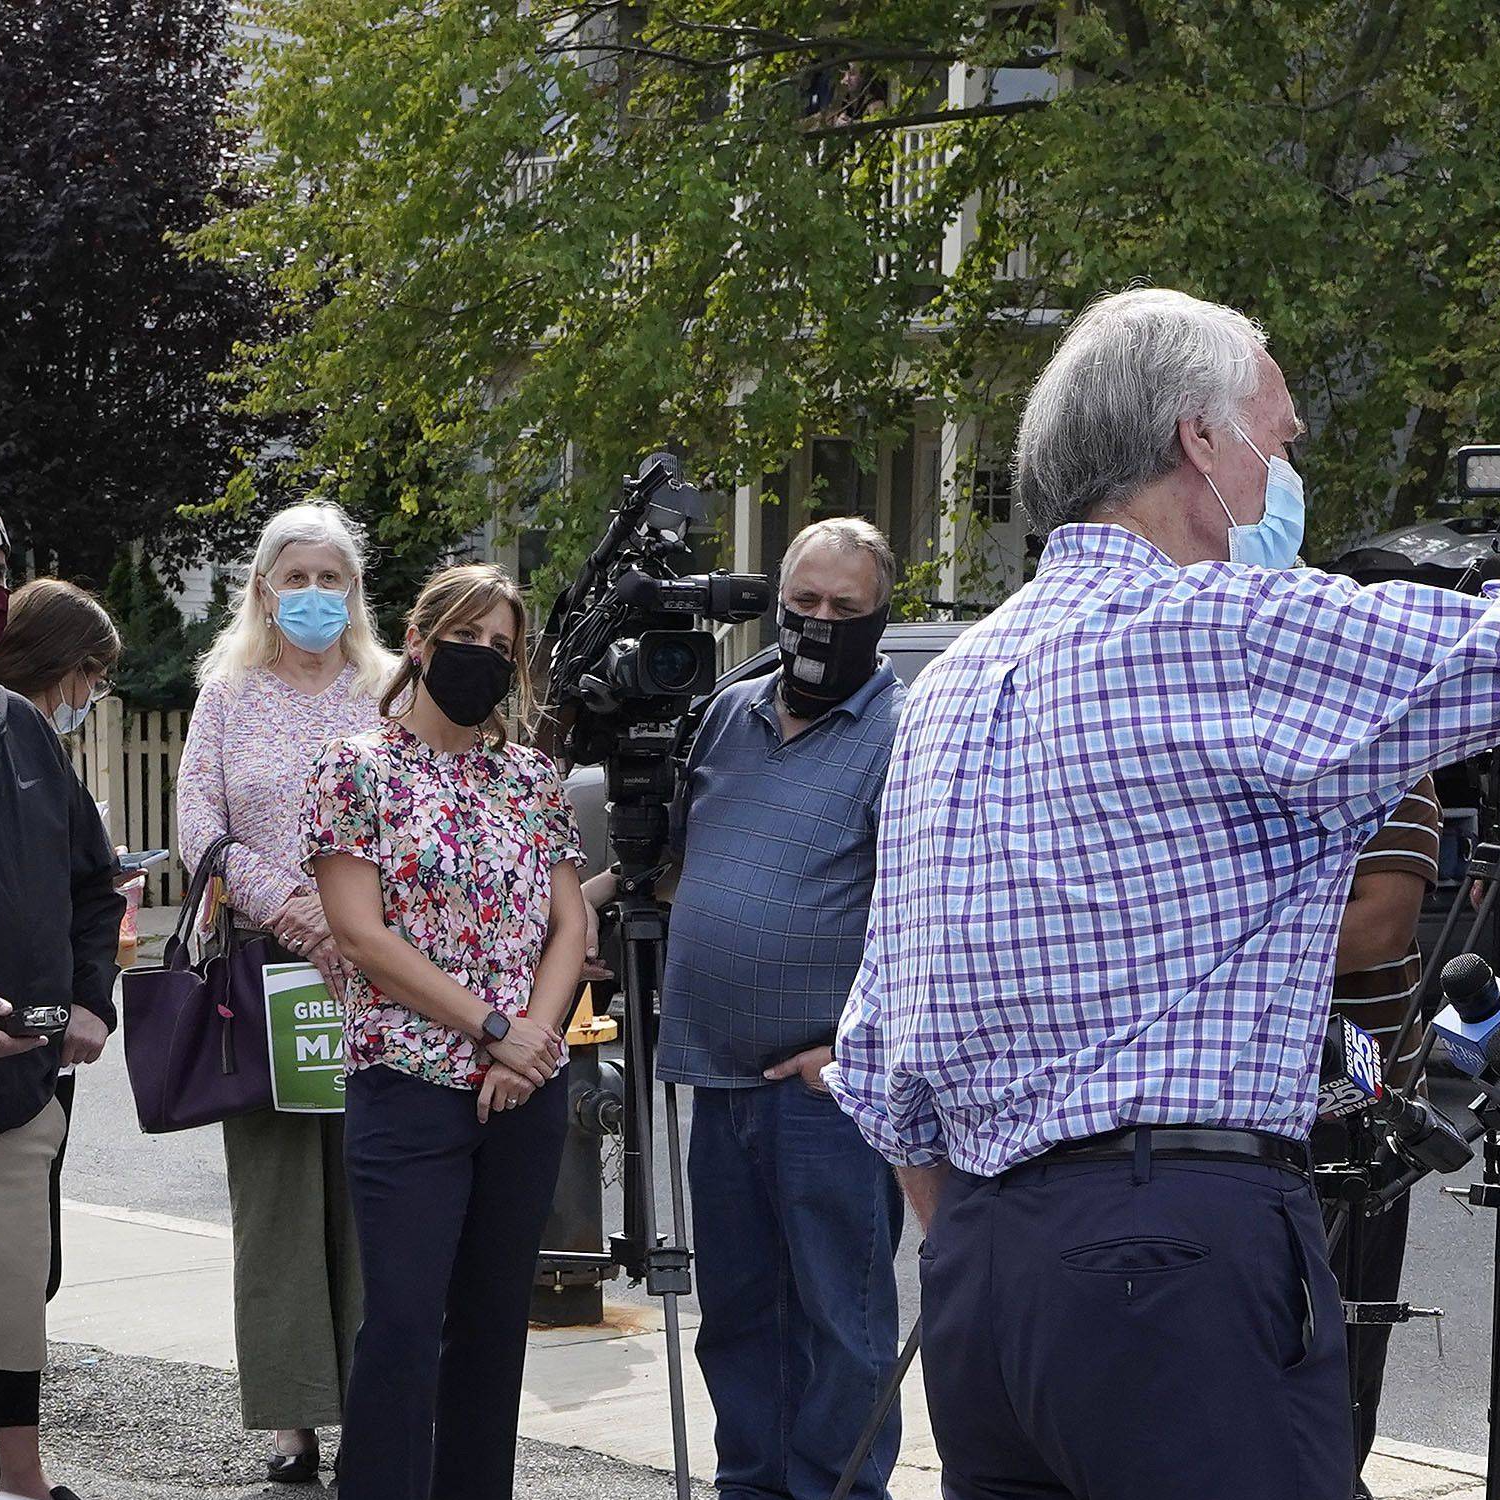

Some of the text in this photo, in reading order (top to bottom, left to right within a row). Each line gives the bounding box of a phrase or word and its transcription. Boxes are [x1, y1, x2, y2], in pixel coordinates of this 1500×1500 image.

[1343, 1019, 1355, 1078] BOSTON
[1351, 1025, 1376, 1092] 25
[1372, 1039, 1383, 1088] NEWS
[1317, 1082, 1365, 1116] 25
[1318, 1076, 1350, 1093] TON
[1333, 1097, 1379, 1118] NEWS
